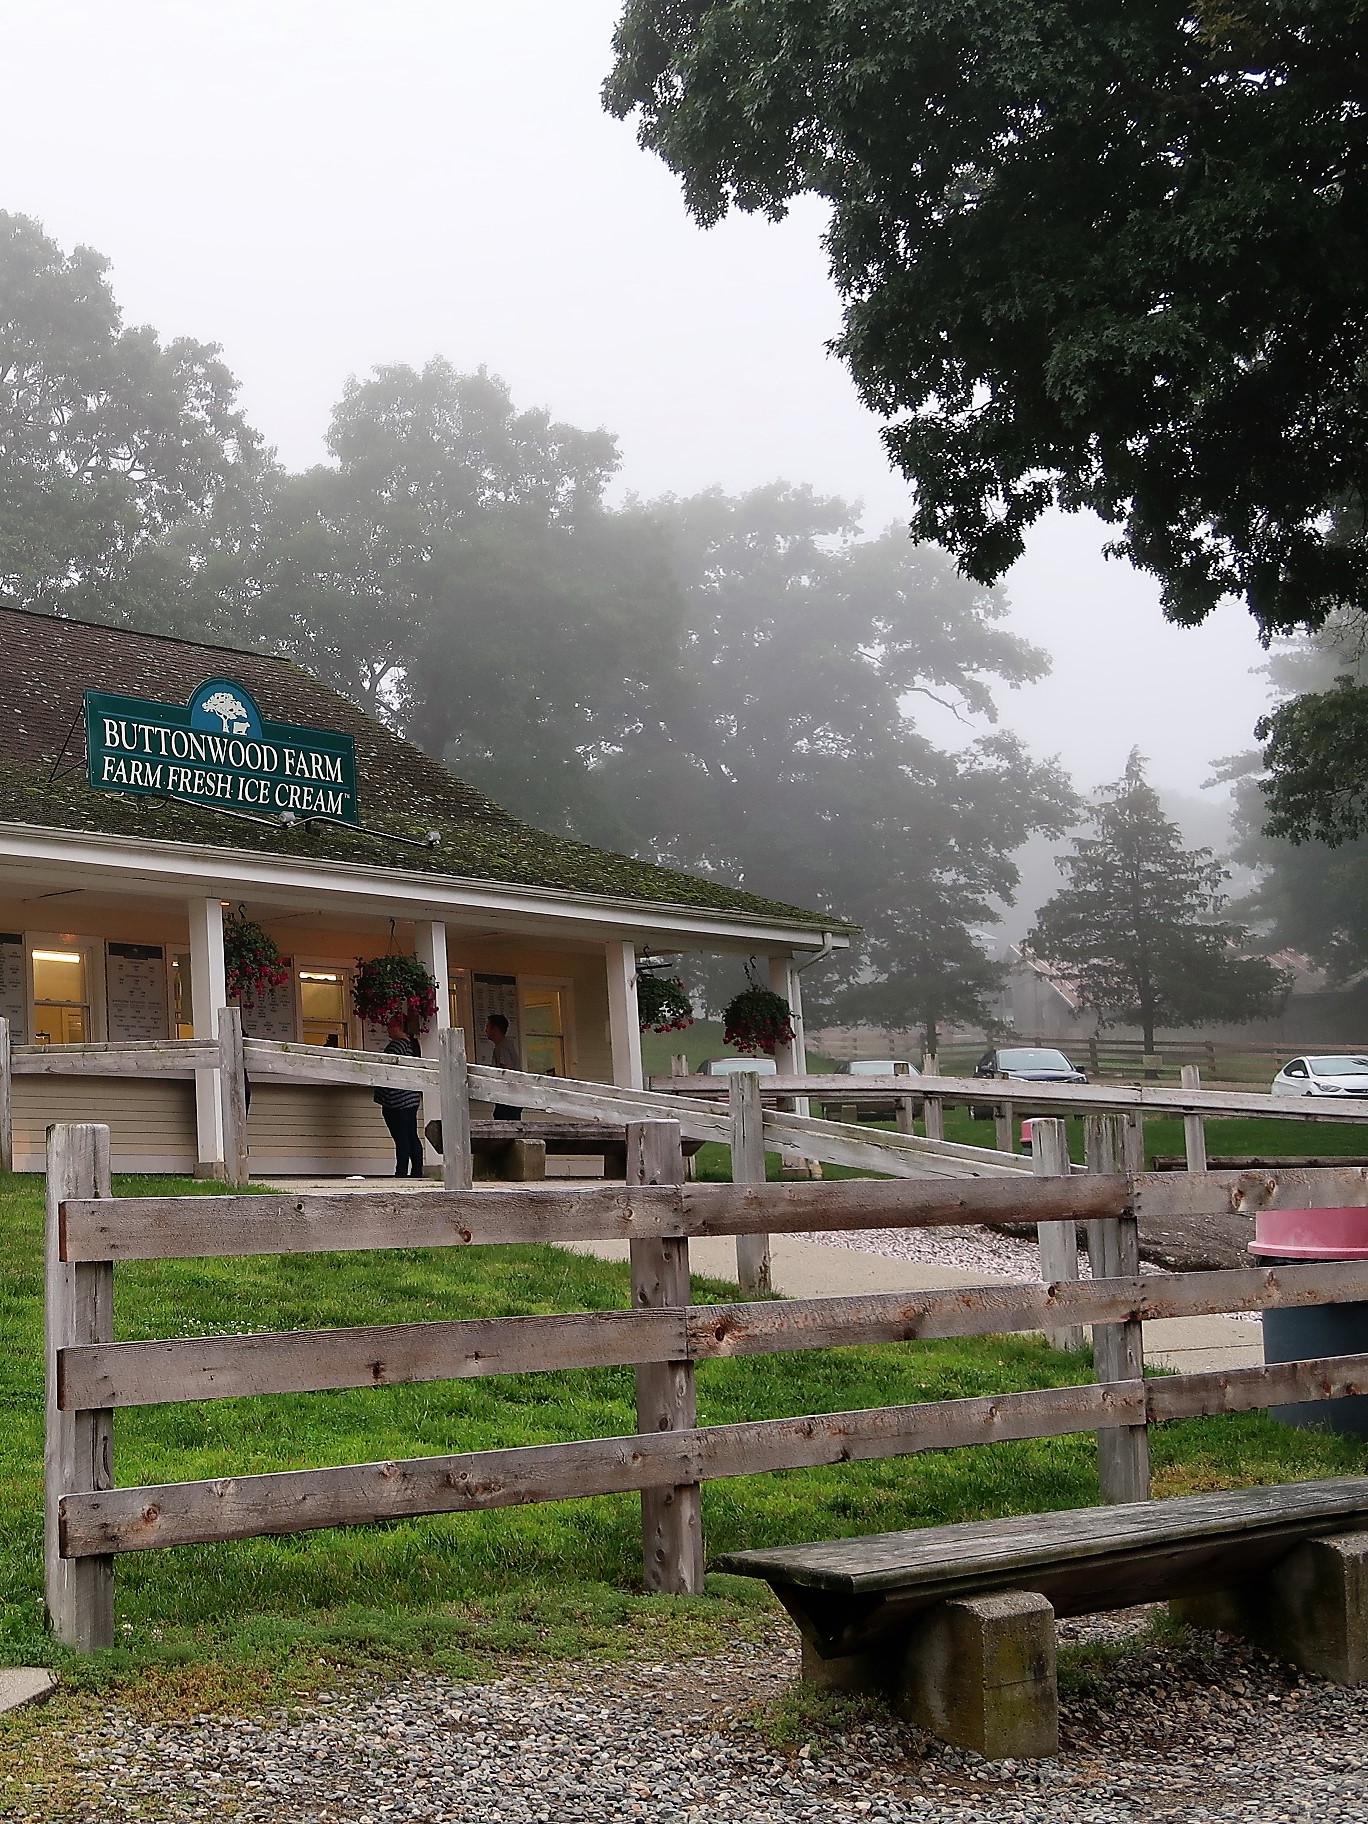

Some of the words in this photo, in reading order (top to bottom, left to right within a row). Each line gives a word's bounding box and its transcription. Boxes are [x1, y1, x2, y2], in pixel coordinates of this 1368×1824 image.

[102, 718, 278, 772] BUTTONWOOD
[282, 748, 344, 783] FARM
[102, 756, 163, 788] FARM
[166, 765, 232, 799] FRESH
[237, 778, 270, 803] ICE
[275, 783, 344, 815] CREAM
